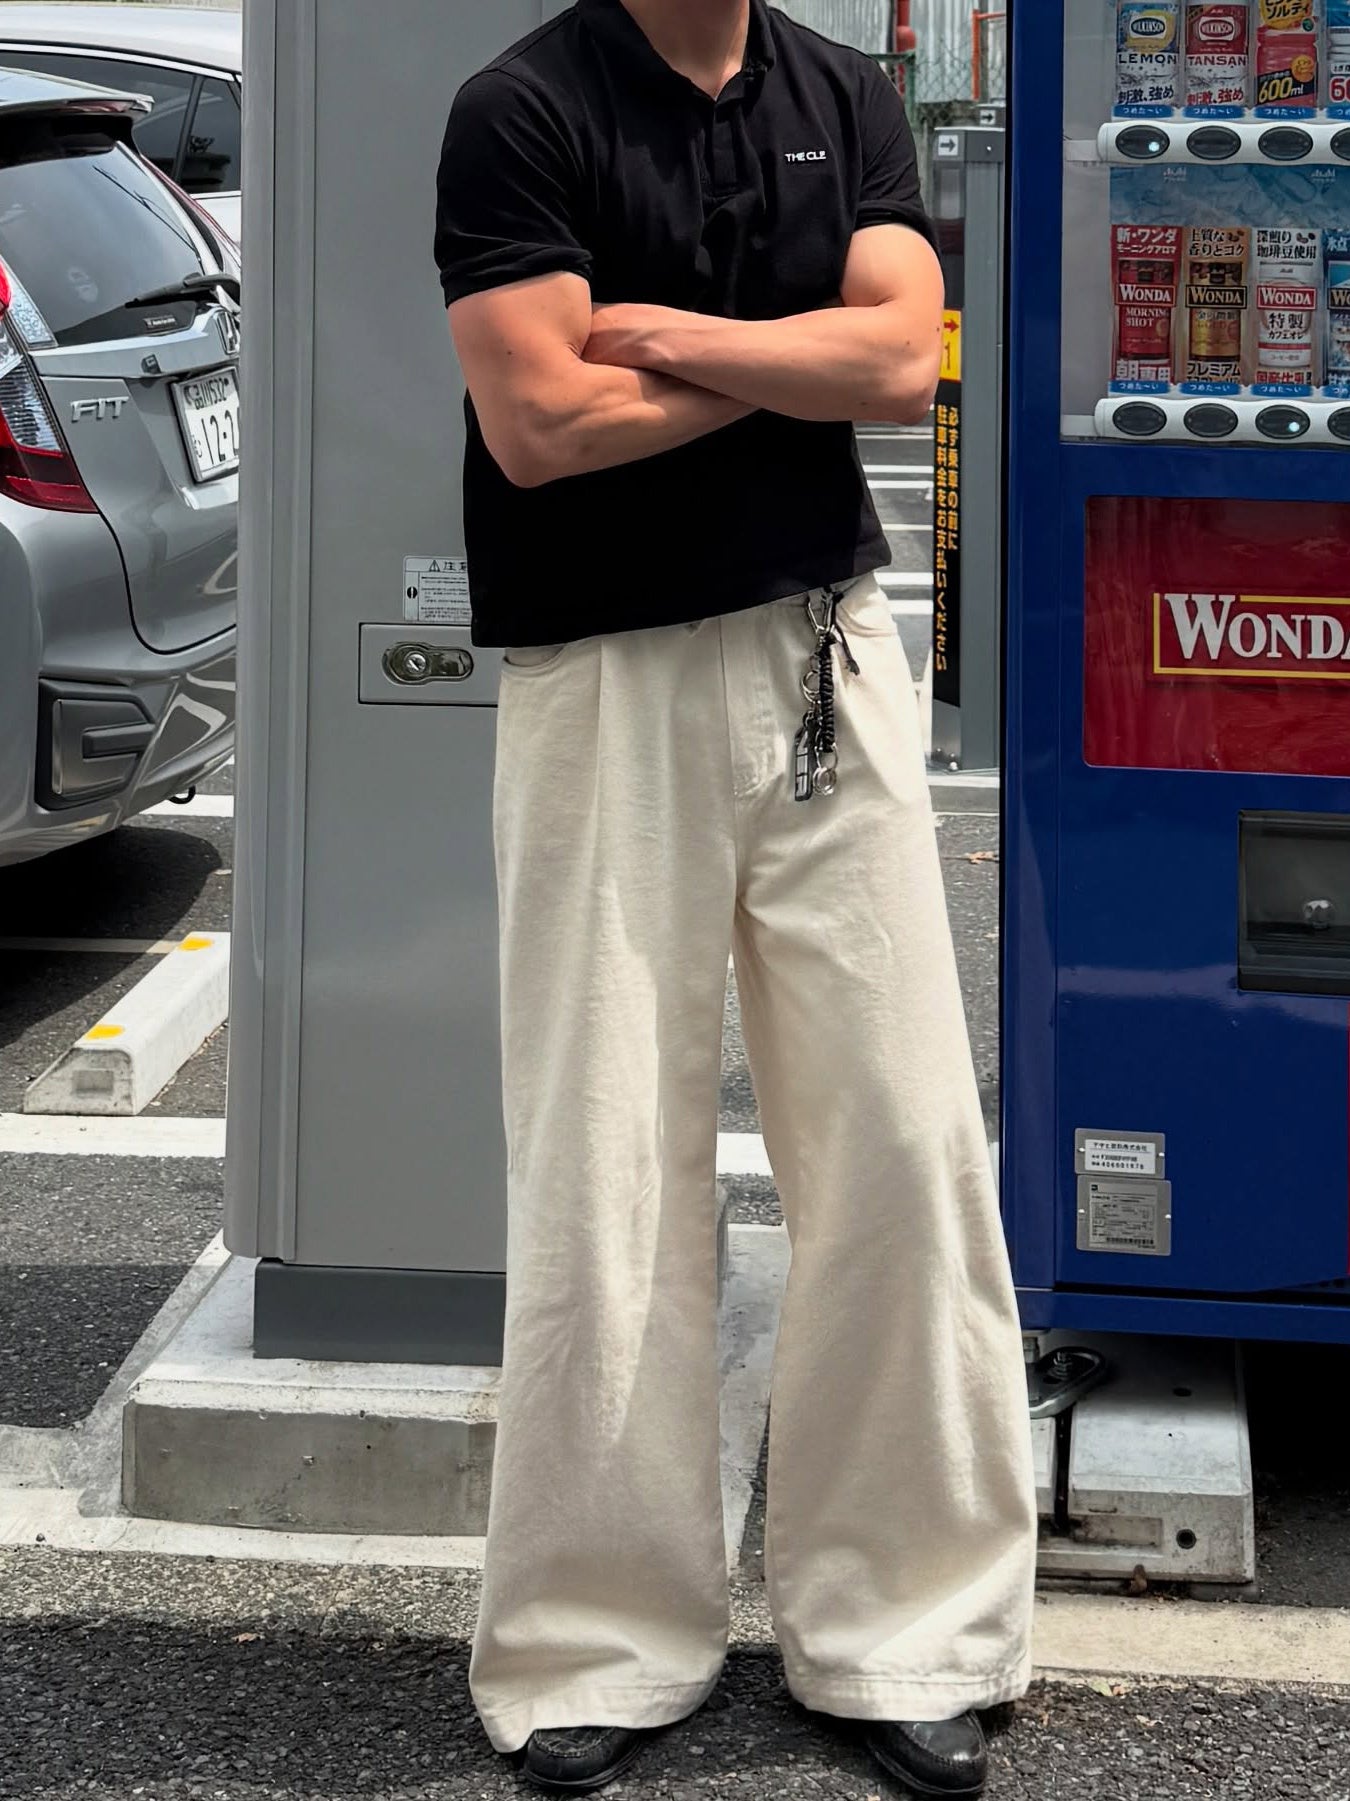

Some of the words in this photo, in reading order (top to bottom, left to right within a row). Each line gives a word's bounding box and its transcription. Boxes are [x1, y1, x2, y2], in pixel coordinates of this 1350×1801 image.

[1118, 54, 1177, 64] LEMON
[1187, 56, 1246, 66] TANSAN
[1118, 85, 1174, 105] 刺激、強め
[1186, 88, 1244, 106] 刺激、強め
[1117, 228, 1177, 243] 新・ワンダ
[1192, 229, 1225, 241] 上質な
[1257, 230, 1291, 243] 深煎り
[1117, 244, 1176, 254] モーニングアロマ
[1190, 243, 1244, 256] 香りとコク
[1257, 244, 1316, 259] 珈琲豆使用
[1120, 284, 1171, 302] WONDA
[1190, 286, 1242, 304] WONDA
[1261, 287, 1312, 305] WONDA
[1126, 307, 1169, 317] MORNING
[1126, 317, 1154, 327] SHOT
[1269, 312, 1303, 329] 特製
[1187, 362, 1241, 377] プレミアム
[70, 396, 130, 424] FIT
[200, 406, 240, 466] 12-2
[936, 404, 948, 672] 駐車料金をお支払いください
[1164, 593, 1350, 661] WOND
